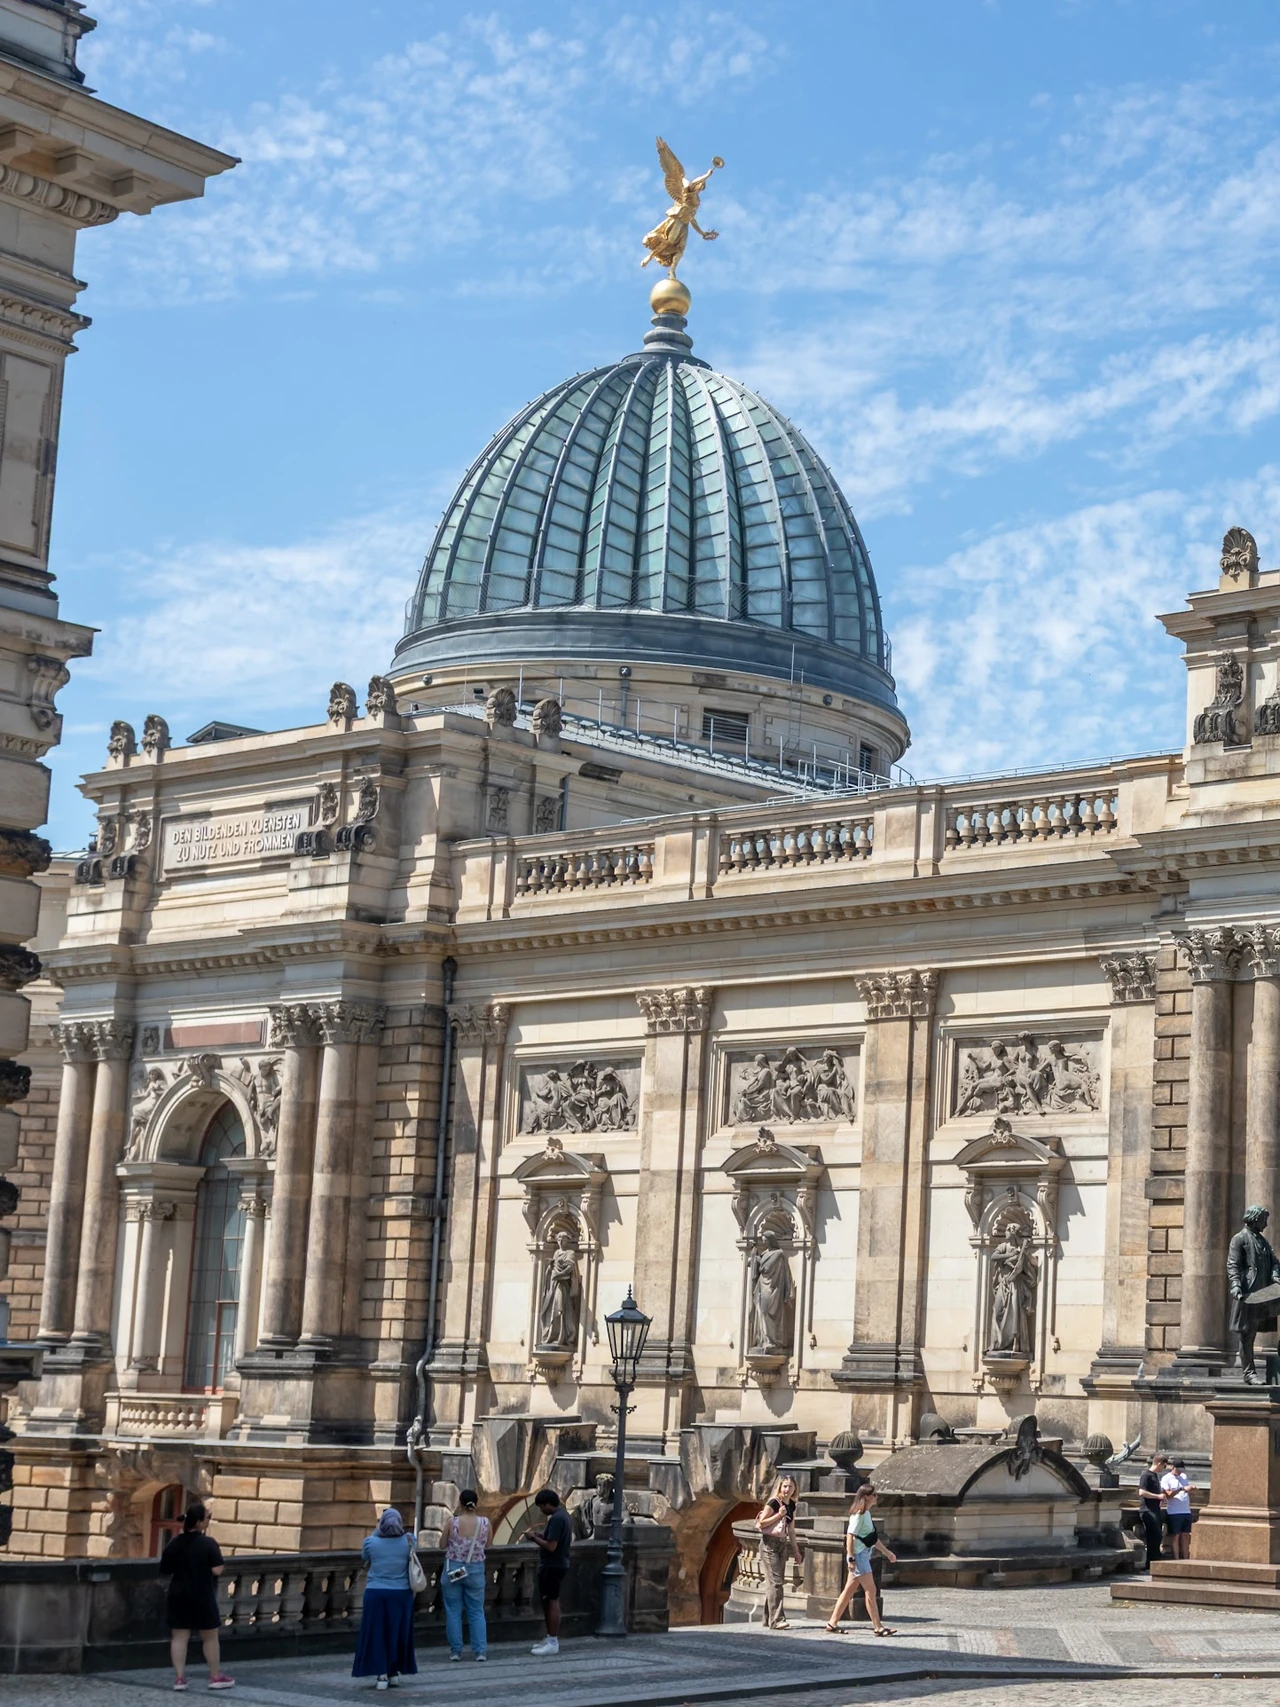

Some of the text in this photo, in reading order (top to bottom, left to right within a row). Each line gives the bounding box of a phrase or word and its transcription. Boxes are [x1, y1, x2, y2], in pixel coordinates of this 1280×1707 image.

[173, 814, 300, 845] DEN BILDENDEN KUENSTEN
[177, 834, 294, 862] ZU NUTZ UND FROMMEN
